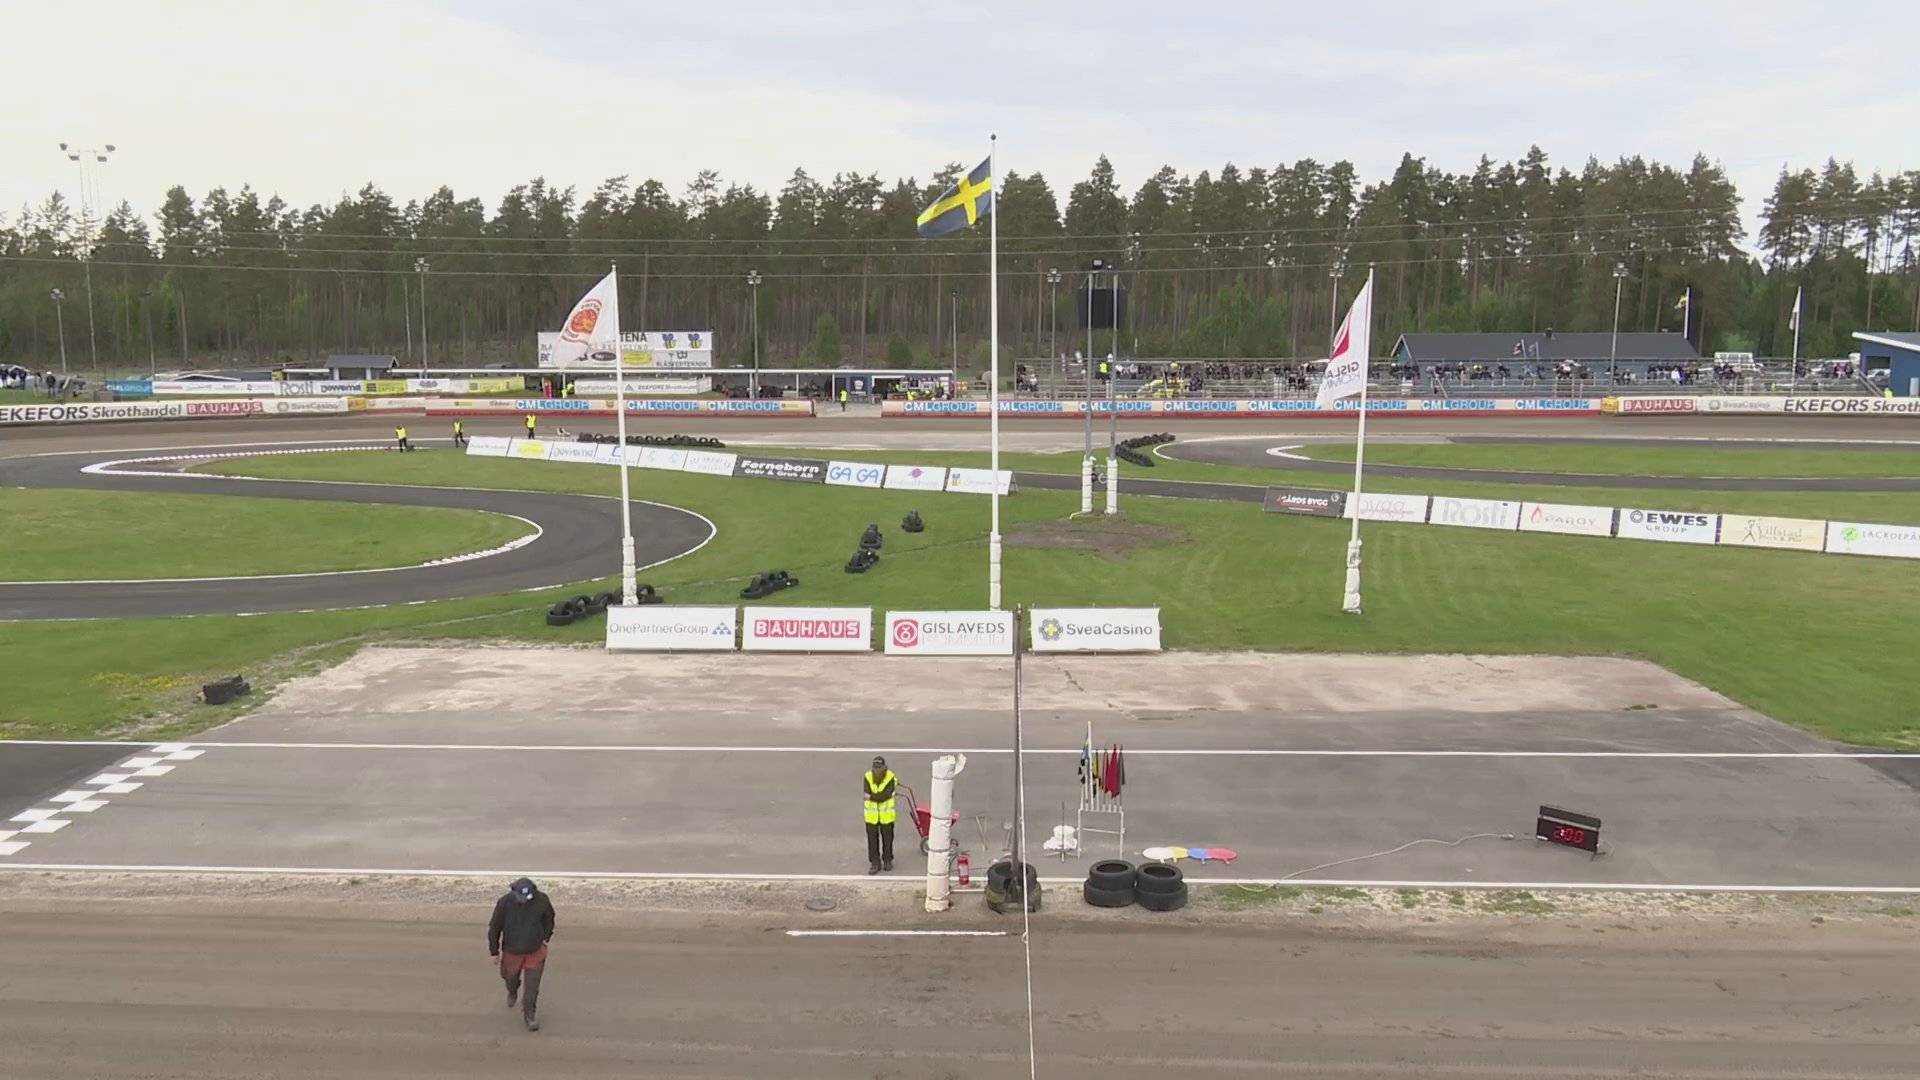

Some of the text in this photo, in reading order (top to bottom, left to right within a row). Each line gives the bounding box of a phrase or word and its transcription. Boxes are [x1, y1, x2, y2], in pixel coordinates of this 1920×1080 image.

[619, 333, 648, 342] TENA
[187, 402, 263, 415] BAUHAUS
[516, 401, 590, 410] CMLGROUP
[628, 401, 699, 410] CMLGROUP
[709, 401, 780, 411] CMLGROUP
[904, 402, 976, 412] CMLGROUP
[1163, 401, 1237, 411] CMLGROUP
[1421, 400, 1495, 410] CMLGROUP
[1515, 400, 1590, 410] CMLGROUP
[1624, 400, 1694, 411] BAUHAUS
[1784, 400, 1869, 412] EKEFORS
[0, 404, 181, 421] EKEFORS Skrothandel
[741, 460, 819, 473] Ferneborn
[1647, 513, 1708, 526] EWES
[1646, 525, 1687, 533] GROUP
[609, 622, 708, 637] OnePartnerGroup
[755, 620, 860, 637] BAUHAUS
[922, 622, 1005, 633] GISLAVEDS
[1066, 623, 1153, 635] SveaCasino
